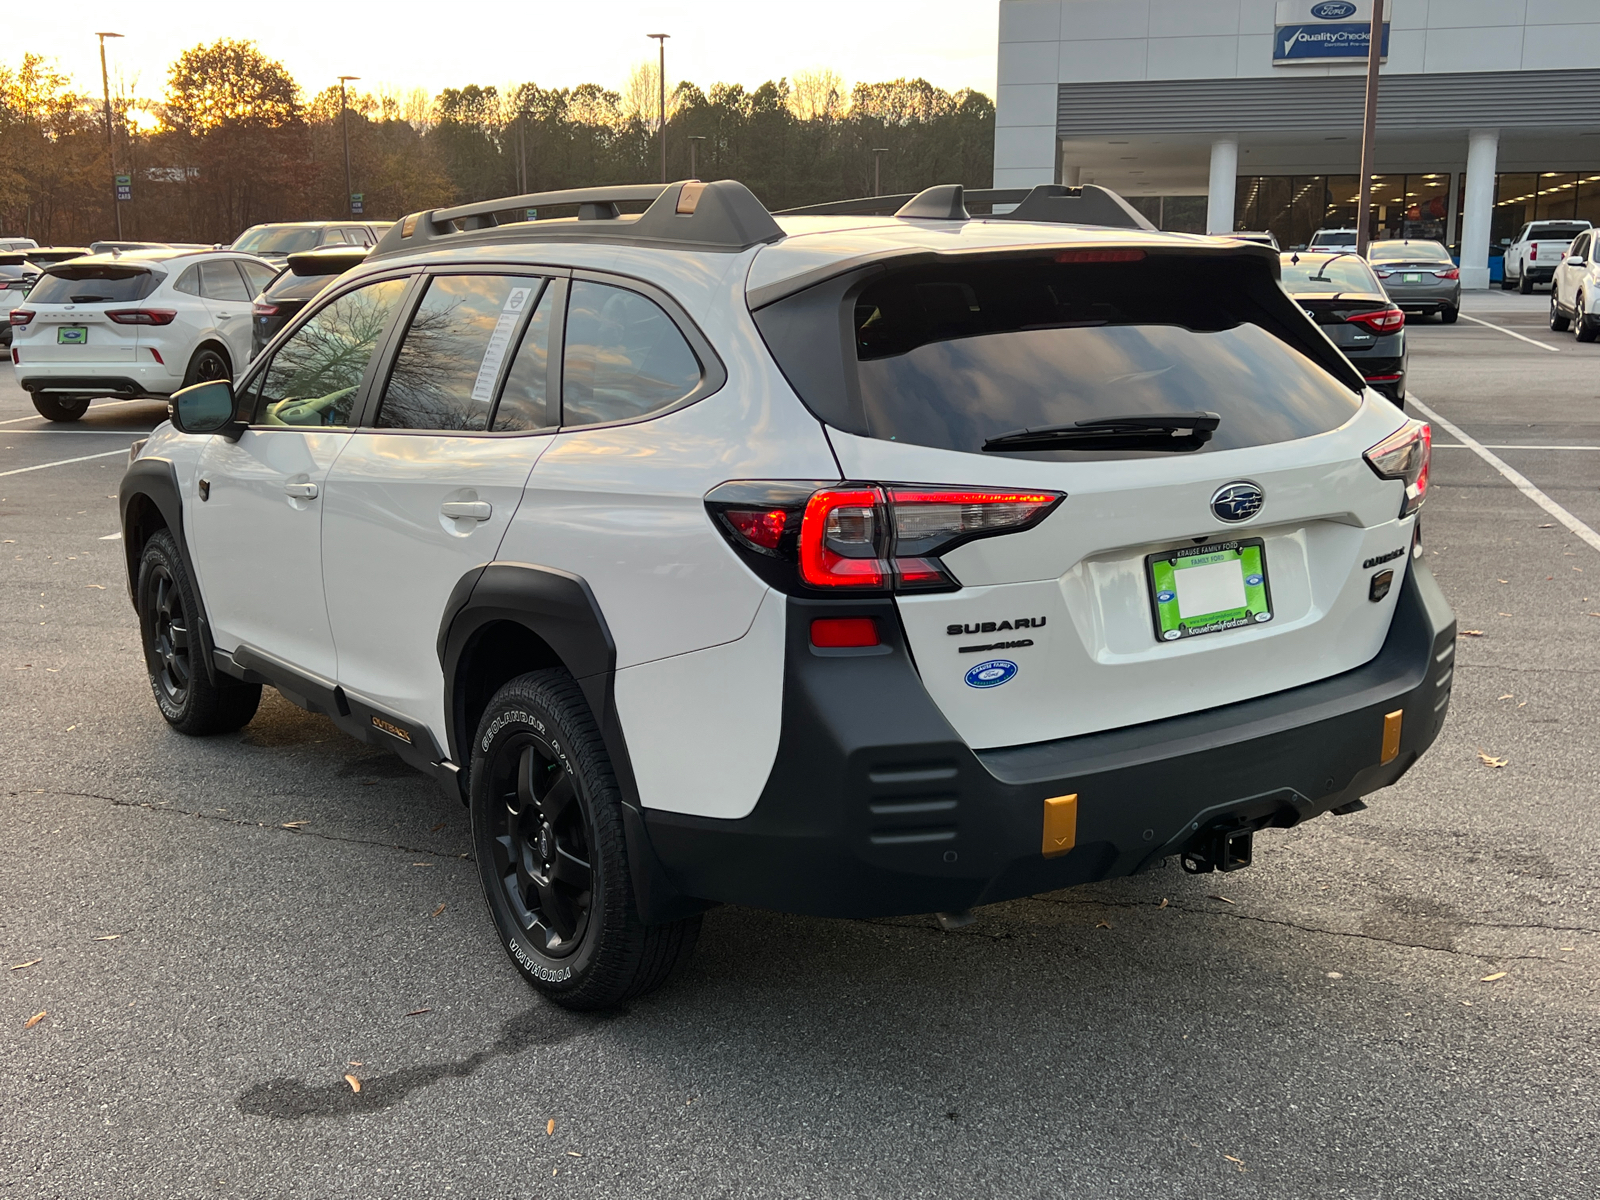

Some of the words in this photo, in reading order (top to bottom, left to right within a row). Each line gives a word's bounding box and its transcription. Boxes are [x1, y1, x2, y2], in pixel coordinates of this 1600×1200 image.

[1321, 4, 1347, 15] Ford
[1177, 548, 1200, 557] KRAUSE
[1201, 545, 1221, 554] FAMILY
[1222, 542, 1238, 550] FORD
[1191, 557, 1209, 565] FAMILY
[947, 616, 1046, 635] SUBARU
[1188, 618, 1248, 635] KrauseFamilyFord.com
[983, 670, 1000, 679] Ford
[372, 716, 411, 741] OUTBACK
[481, 710, 547, 753] GEOLANDAR
[508, 937, 572, 982] YOKOHAMA
